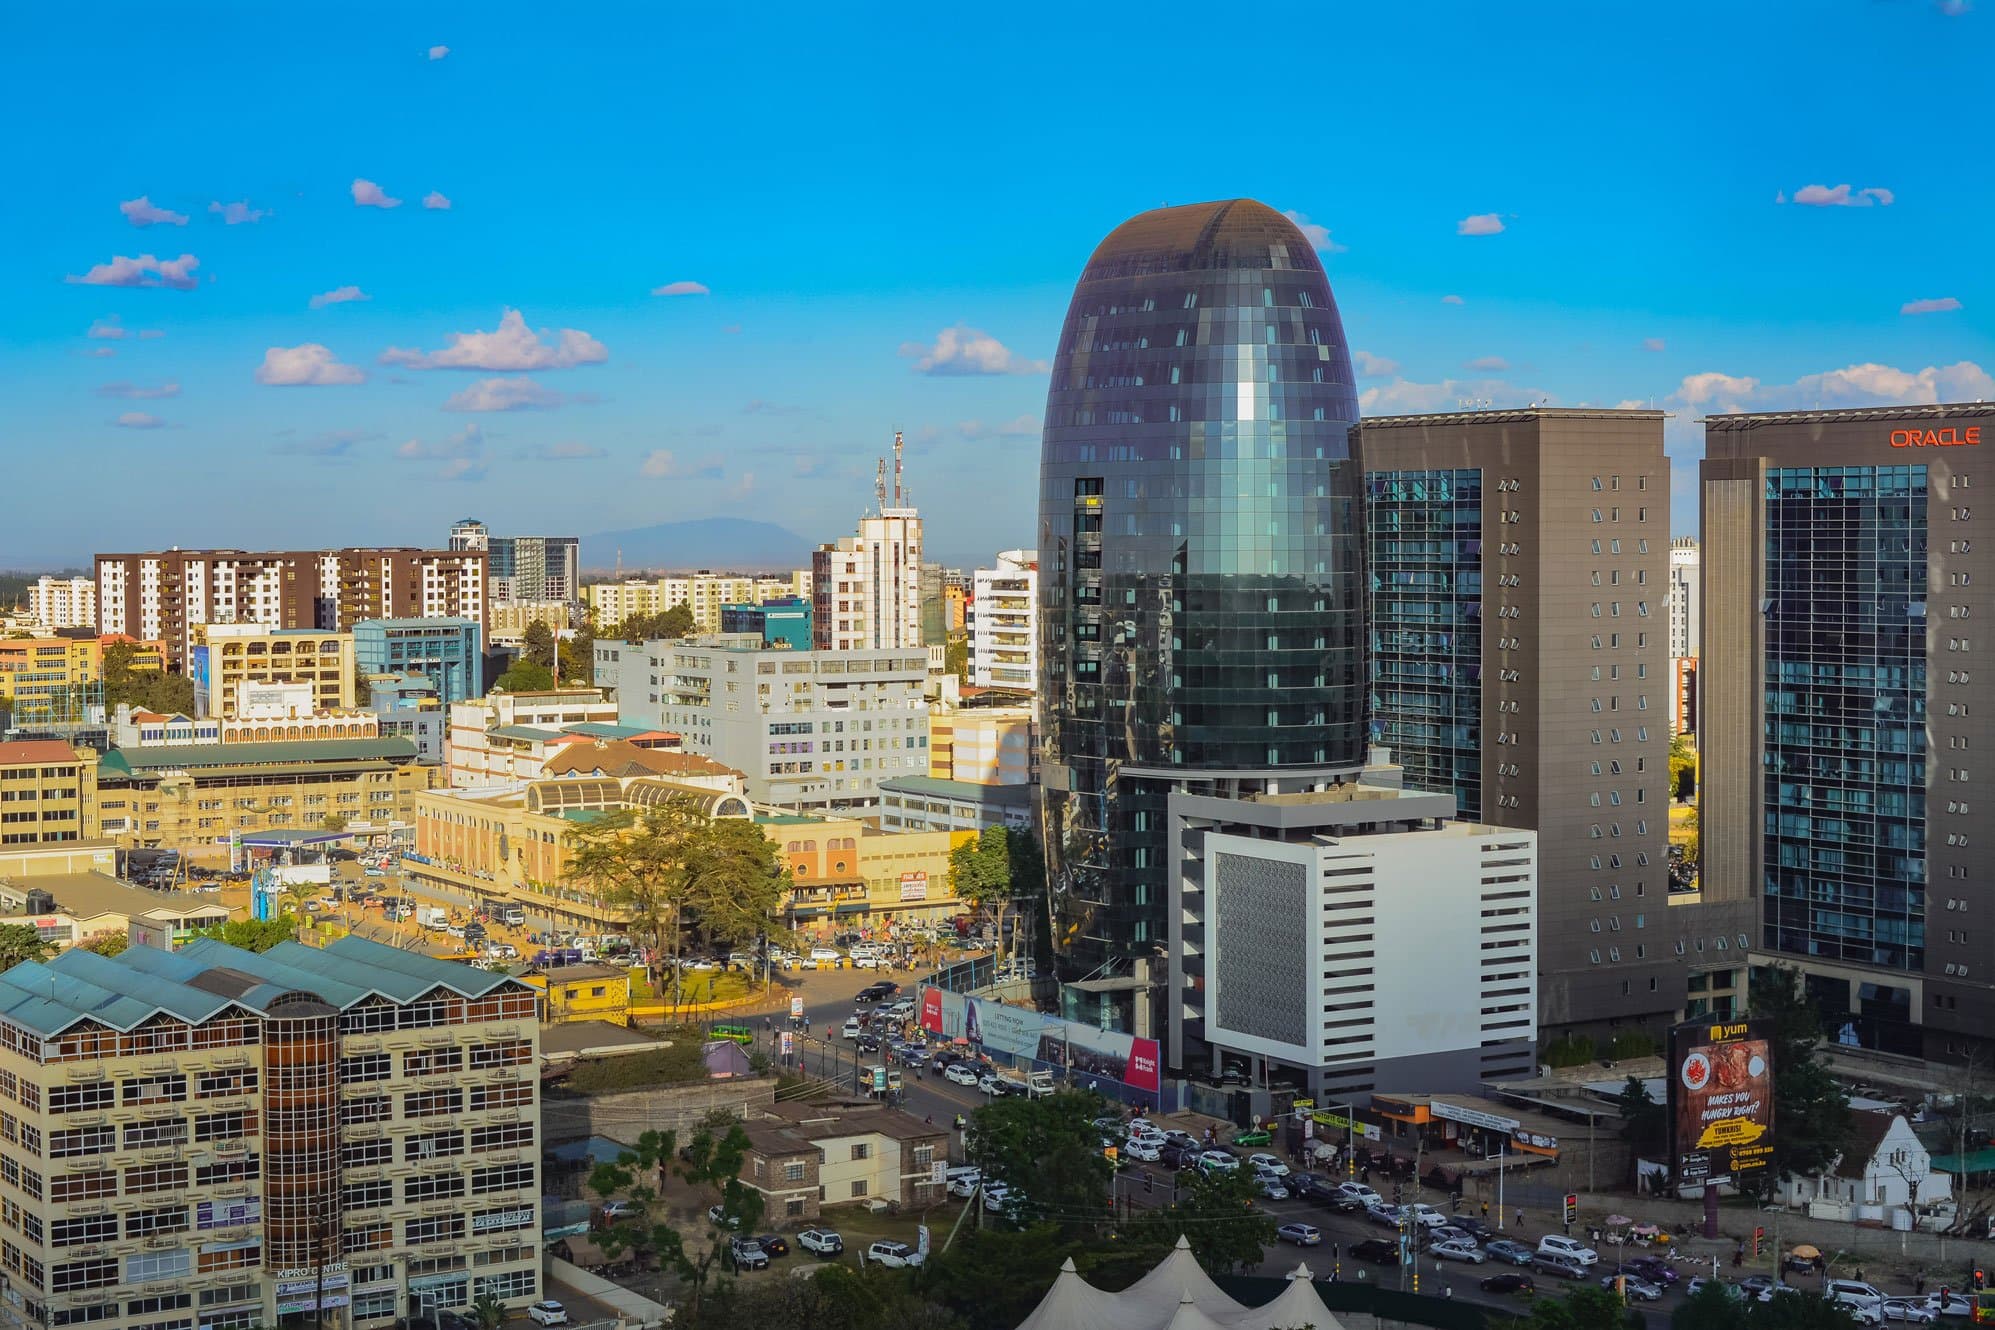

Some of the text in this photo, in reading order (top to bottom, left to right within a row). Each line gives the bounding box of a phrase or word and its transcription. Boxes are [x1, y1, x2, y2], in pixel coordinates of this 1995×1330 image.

[1890, 426, 1981, 448] ORACLE
[1724, 1024, 1747, 1038] yum
[1707, 1091, 1750, 1106] MAKES YOU
[1701, 1100, 1760, 1120] HUNGRY RIGHT?
[1313, 1112, 1358, 1128] AUTOFIT GARGE
[277, 1262, 348, 1279] KIPRO CNTRE
